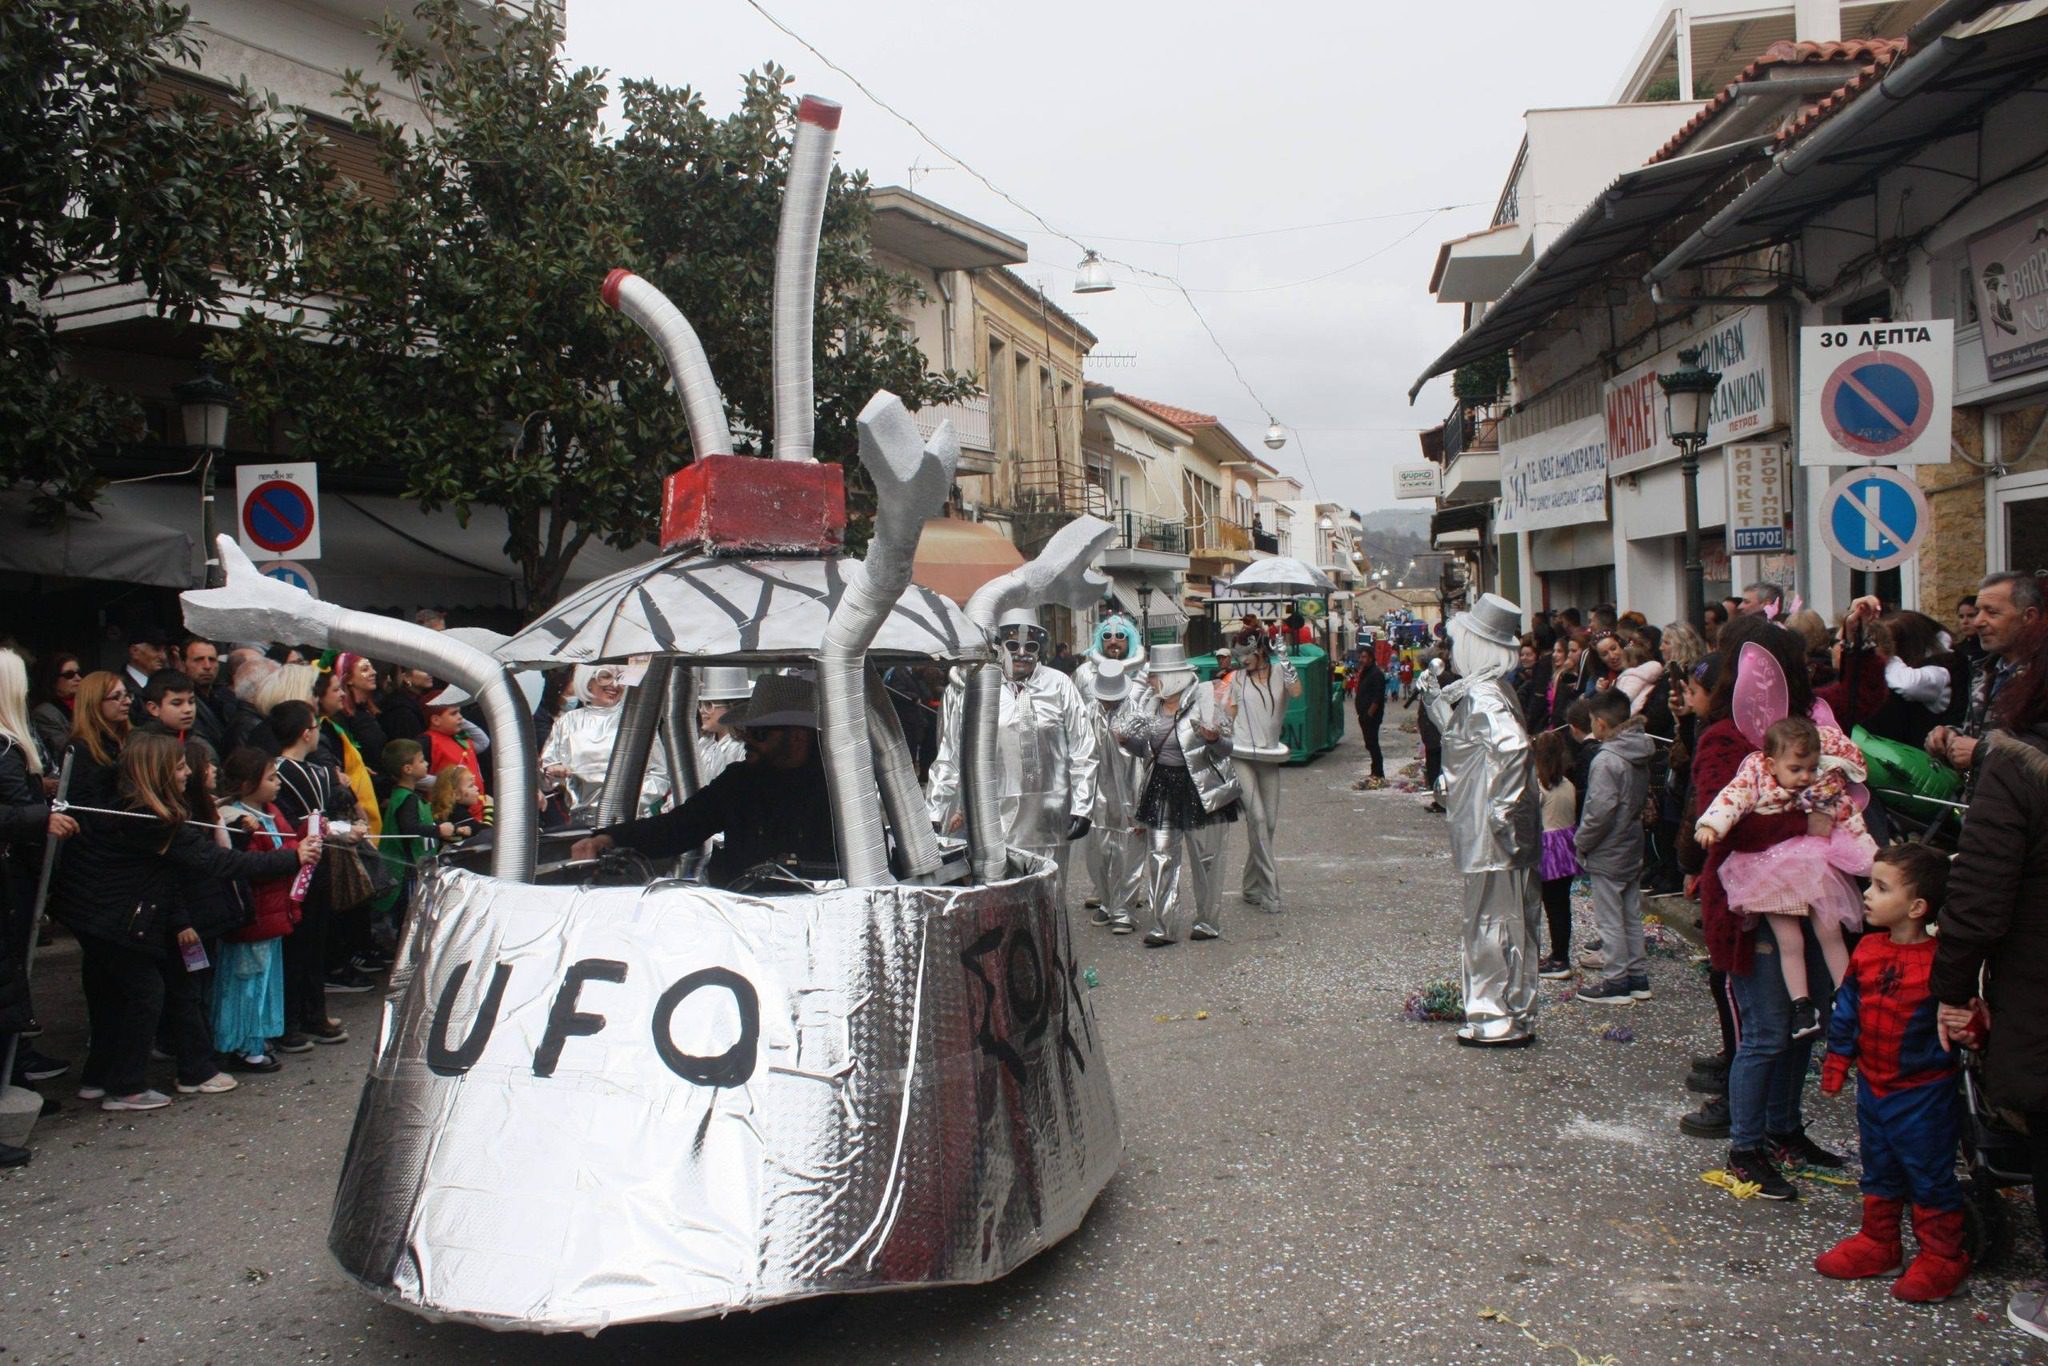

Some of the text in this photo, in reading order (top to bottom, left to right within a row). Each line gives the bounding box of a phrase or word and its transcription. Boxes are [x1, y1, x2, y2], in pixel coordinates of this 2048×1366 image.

[1820, 327, 1931, 348] 30 ΛΕΠΤΑ
[1606, 370, 1657, 460] MARKET
[1729, 415, 1759, 432] ΠΕΤΡΟΣ
[1735, 447, 1754, 527] MARKET
[1761, 447, 1779, 526] ΤΡΟΦΙΜΩΝ
[1736, 530, 1781, 548] ΠΕΤΡΟΣ
[426, 958, 759, 1088] UFO
